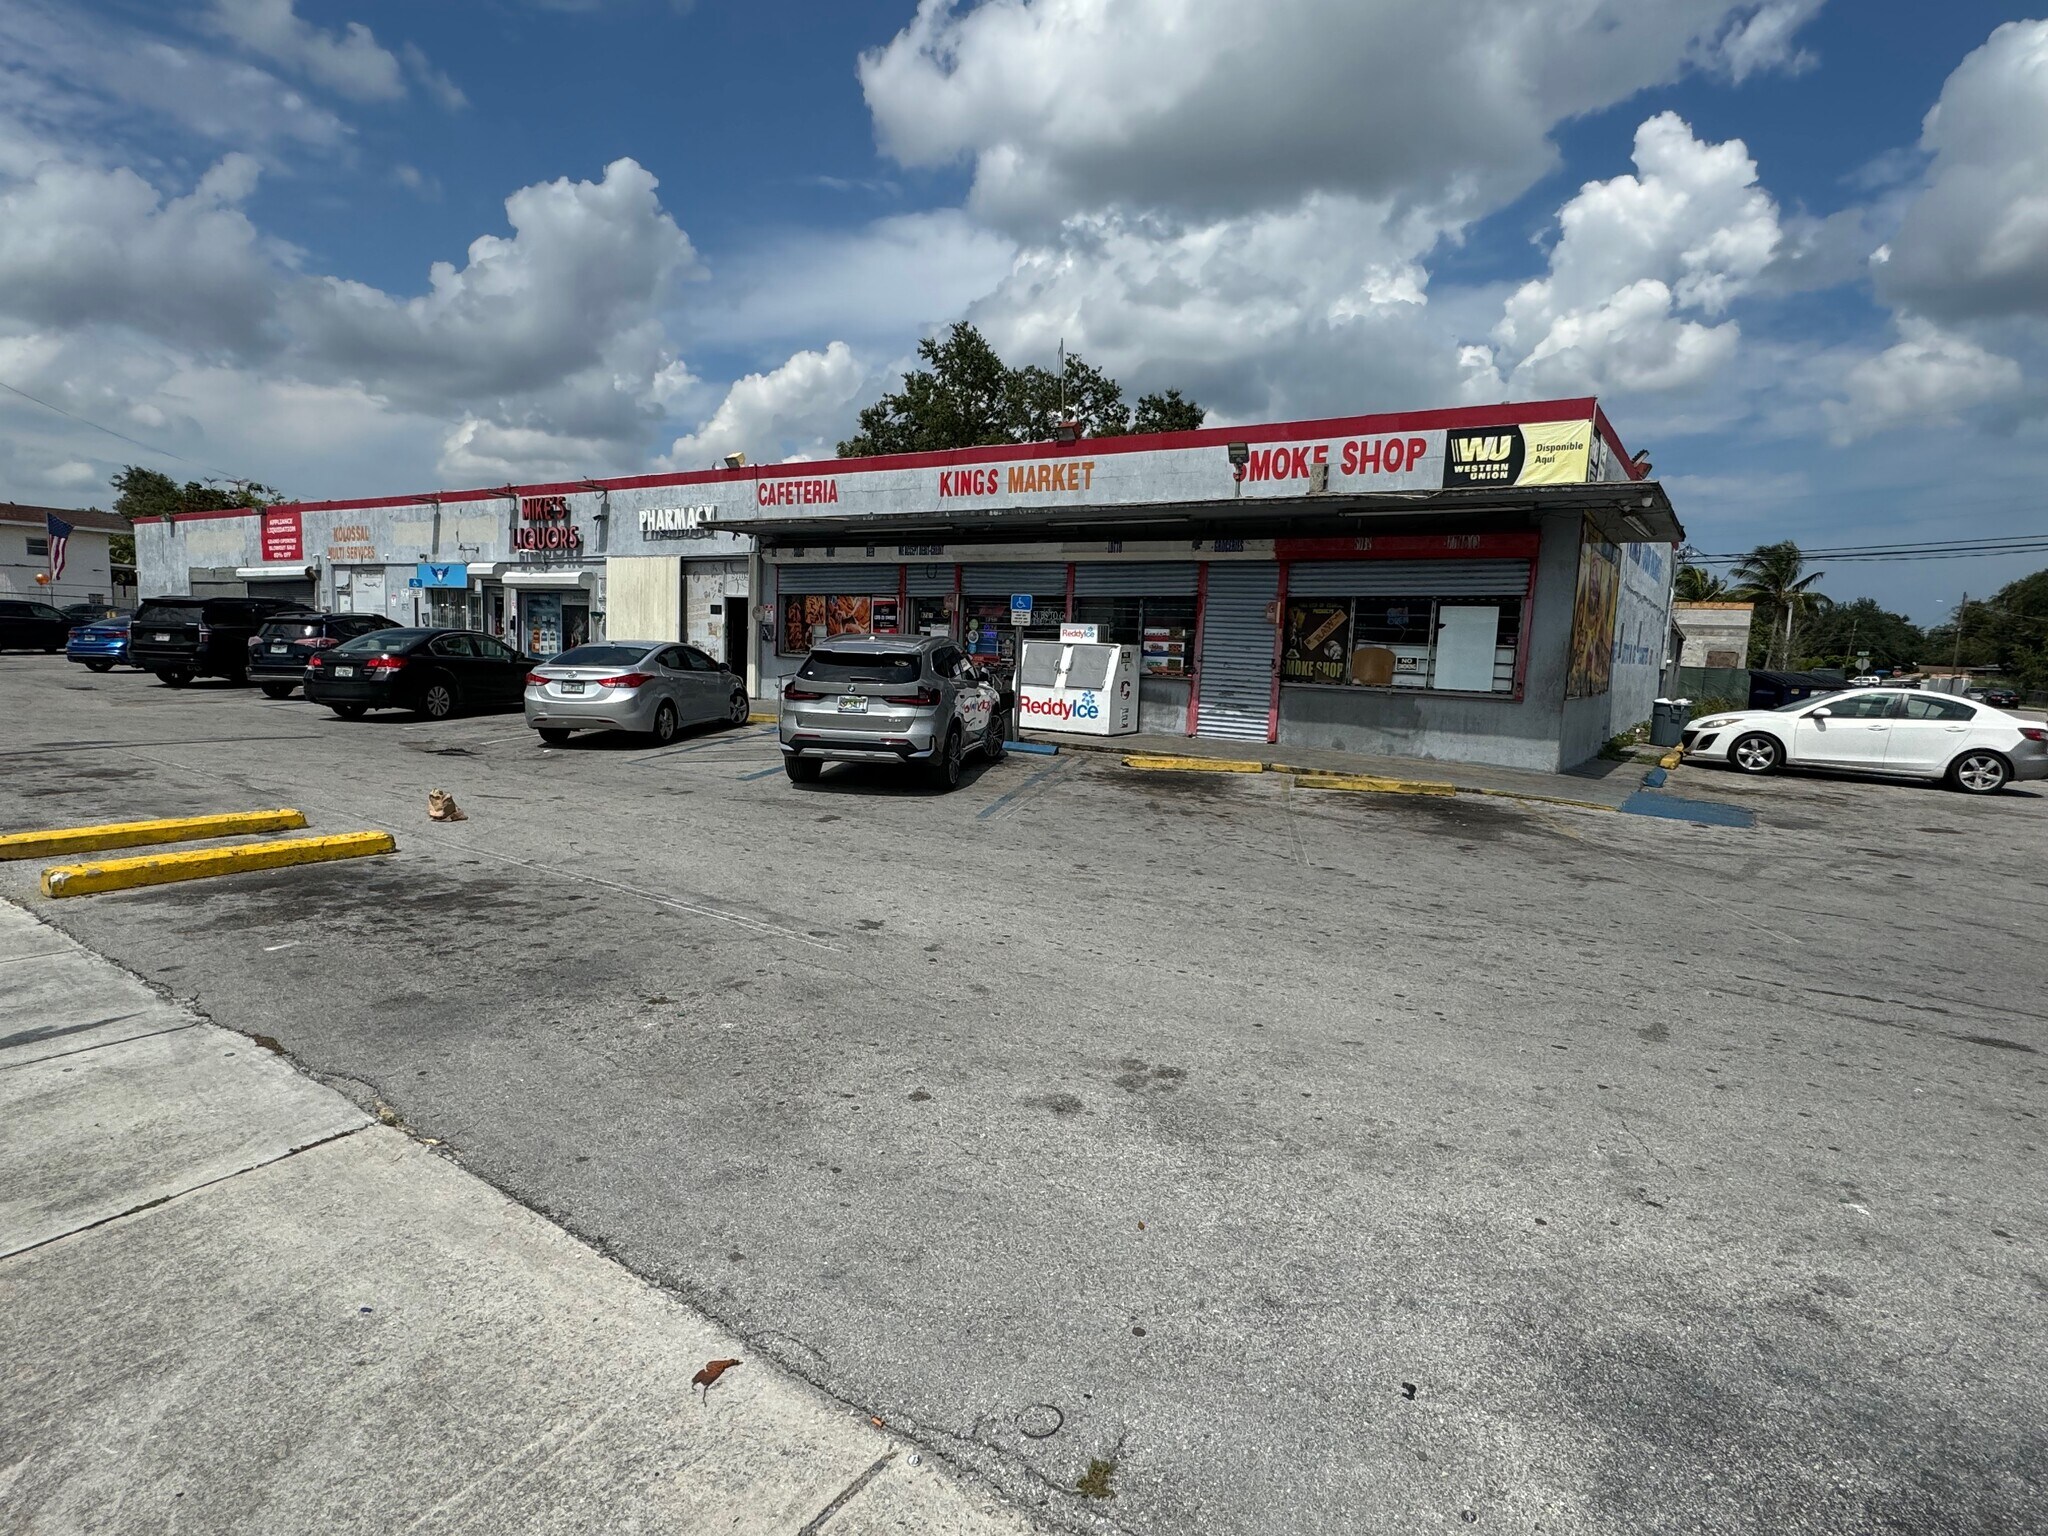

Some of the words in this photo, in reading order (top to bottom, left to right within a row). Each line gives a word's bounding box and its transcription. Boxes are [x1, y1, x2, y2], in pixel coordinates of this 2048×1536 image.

[1340, 437, 1428, 476] SHOP
[1451, 435, 1512, 463] WU
[1536, 441, 1584, 453] Disponible
[939, 468, 999, 498] KINGS
[1007, 461, 1095, 494] MARKET
[1454, 463, 1509, 473] WESTERN
[1470, 471, 1509, 480] UNION
[757, 479, 839, 507] CAFETERIA
[522, 496, 567, 520] MIKE'S
[638, 504, 714, 532] PHARMACY
[333, 525, 370, 542] KOLOSSAL
[512, 526, 580, 549] LIQUORS
[328, 546, 345, 560] MULTI
[346, 545, 375, 559] SERVICES
[1062, 629, 1095, 639] ReddyIce
[1316, 661, 1344, 678] SHOP
[1020, 695, 1099, 720] ReddyIce
